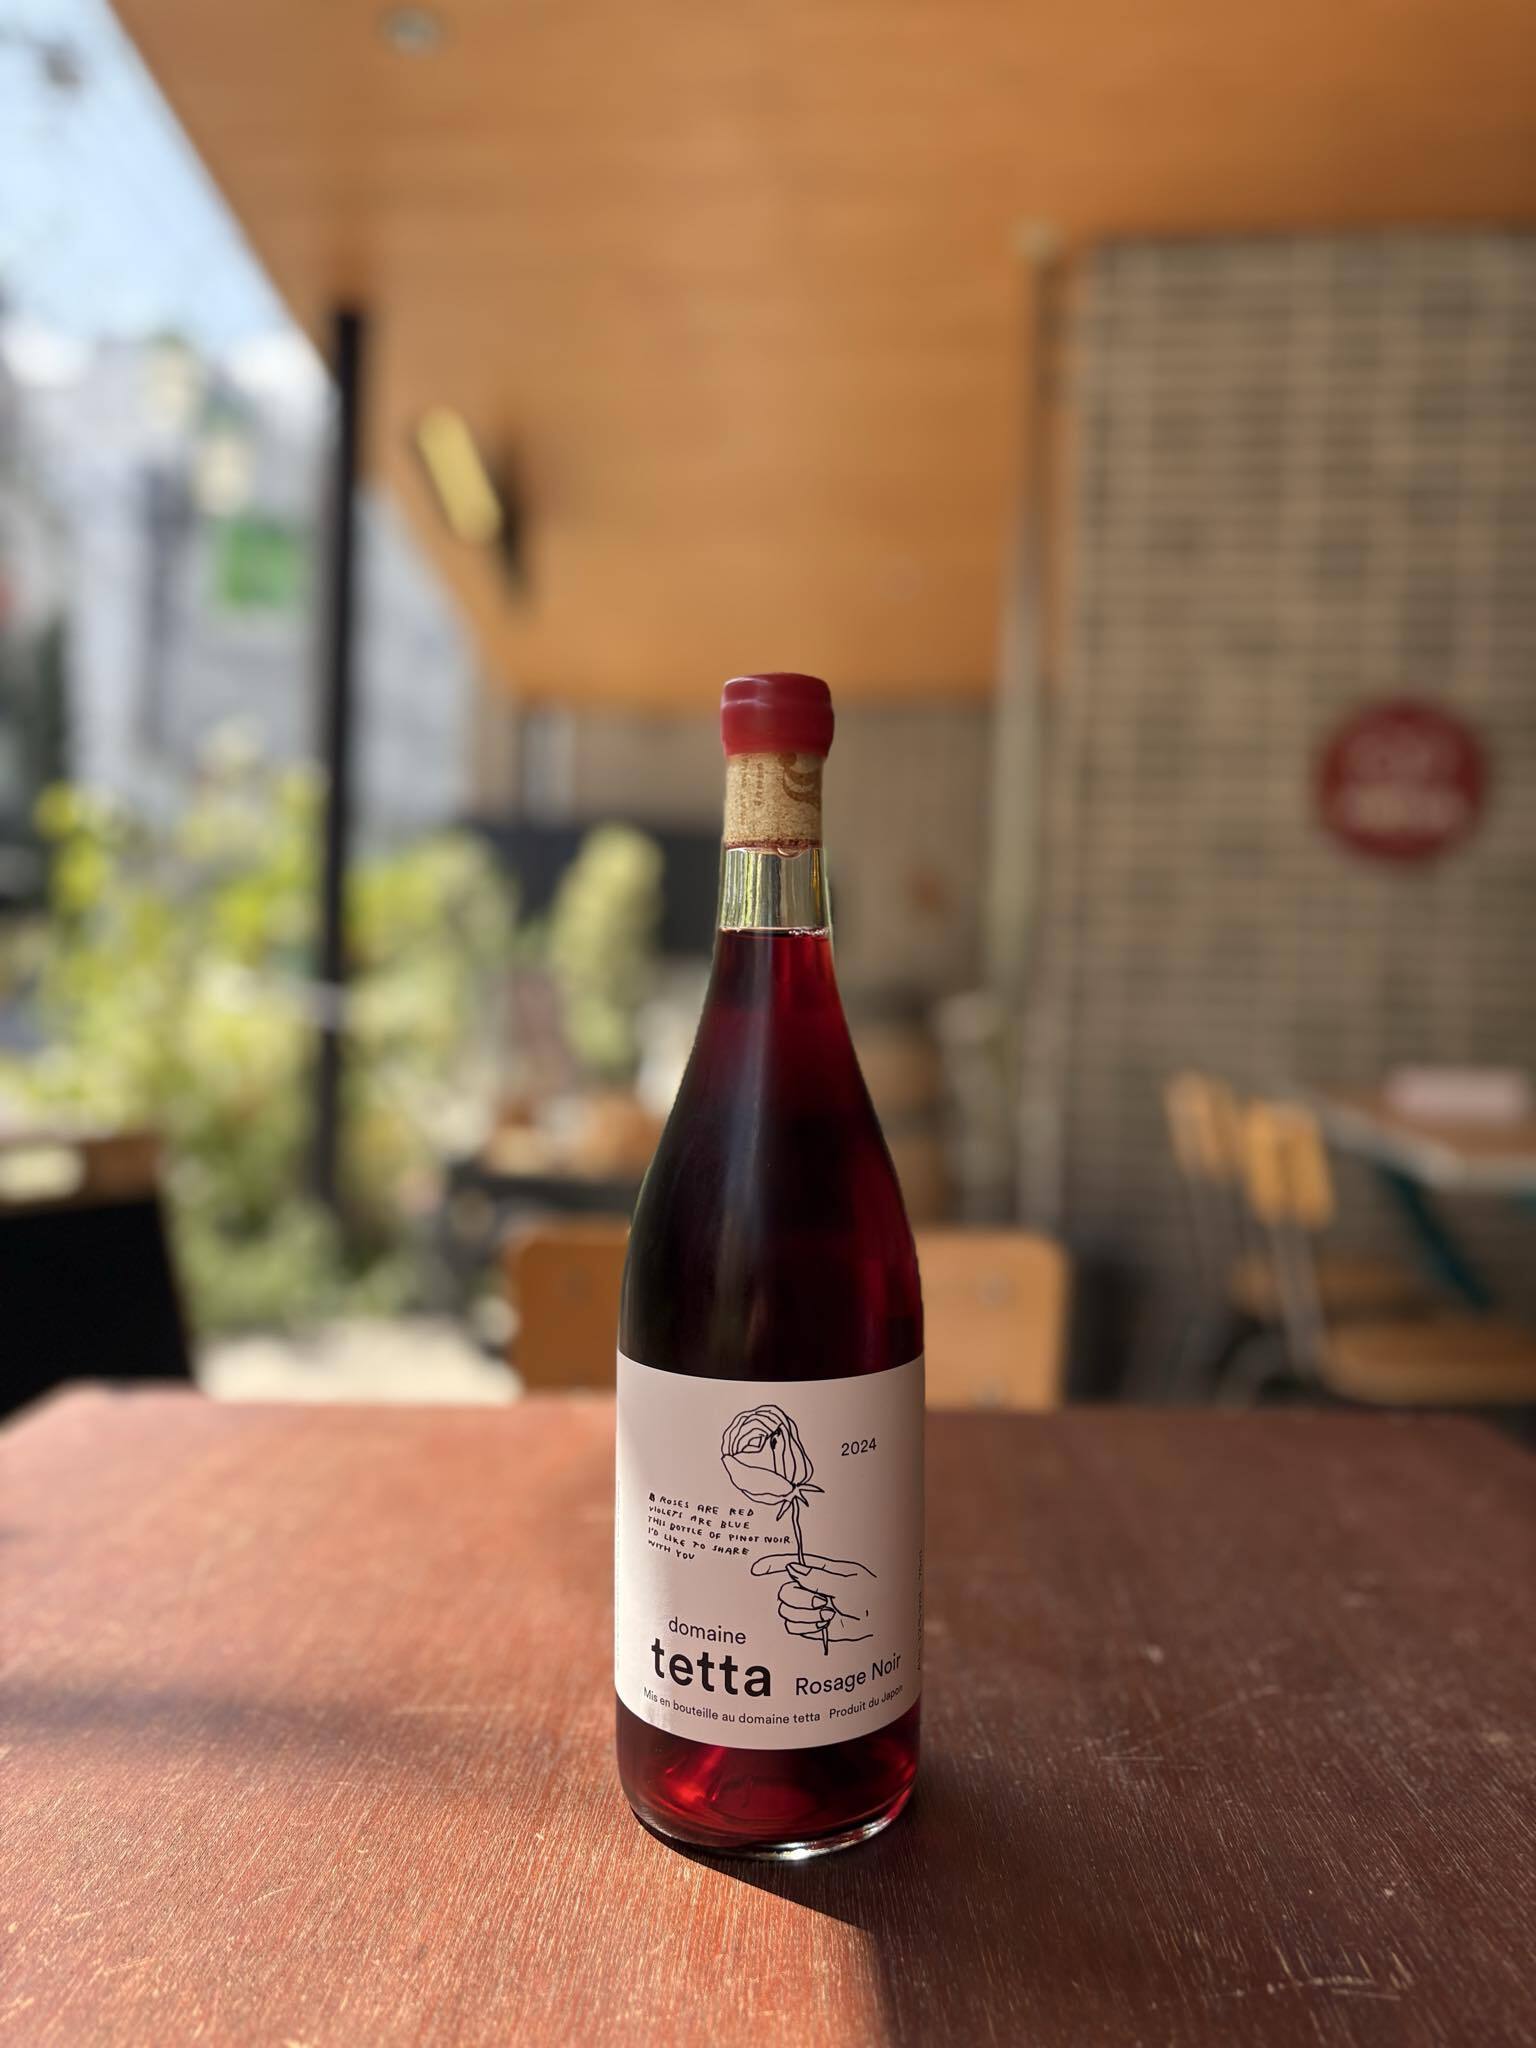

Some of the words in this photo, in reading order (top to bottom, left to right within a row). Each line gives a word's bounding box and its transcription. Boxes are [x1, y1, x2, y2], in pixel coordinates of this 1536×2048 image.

[841, 1437, 877, 1456] 2024
[660, 1496, 689, 1508] ROSES
[697, 1504, 720, 1516] ARE
[729, 1507, 754, 1517] RED
[647, 1515, 666, 1527] THIS
[669, 1522, 703, 1536] BOTTLE
[709, 1531, 721, 1540] OF
[729, 1533, 760, 1543] PINOT
[764, 1536, 791, 1544] NOIR
[690, 1515, 712, 1527] ARE
[720, 1520, 750, 1530] BLUE
[648, 1527, 659, 1537] I'D
[664, 1533, 686, 1547] LIKE
[692, 1541, 706, 1550] TO
[712, 1544, 751, 1556] SHARE
[648, 1540, 671, 1553] WITH
[675, 1549, 695, 1560] YOU
[668, 1616, 747, 1645] domaine
[651, 1637, 772, 1698] tetta
[795, 1671, 867, 1696] Rosage
[871, 1652, 901, 1681] Noir
[643, 1686, 658, 1703] Mis
[659, 1697, 671, 1708] en
[673, 1700, 719, 1720] bouteille
[722, 1713, 735, 1723] au
[738, 1713, 790, 1725] domaine
[793, 1712, 821, 1723] tetta
[829, 1701, 866, 1719] Produit
[868, 1697, 880, 1709] du
